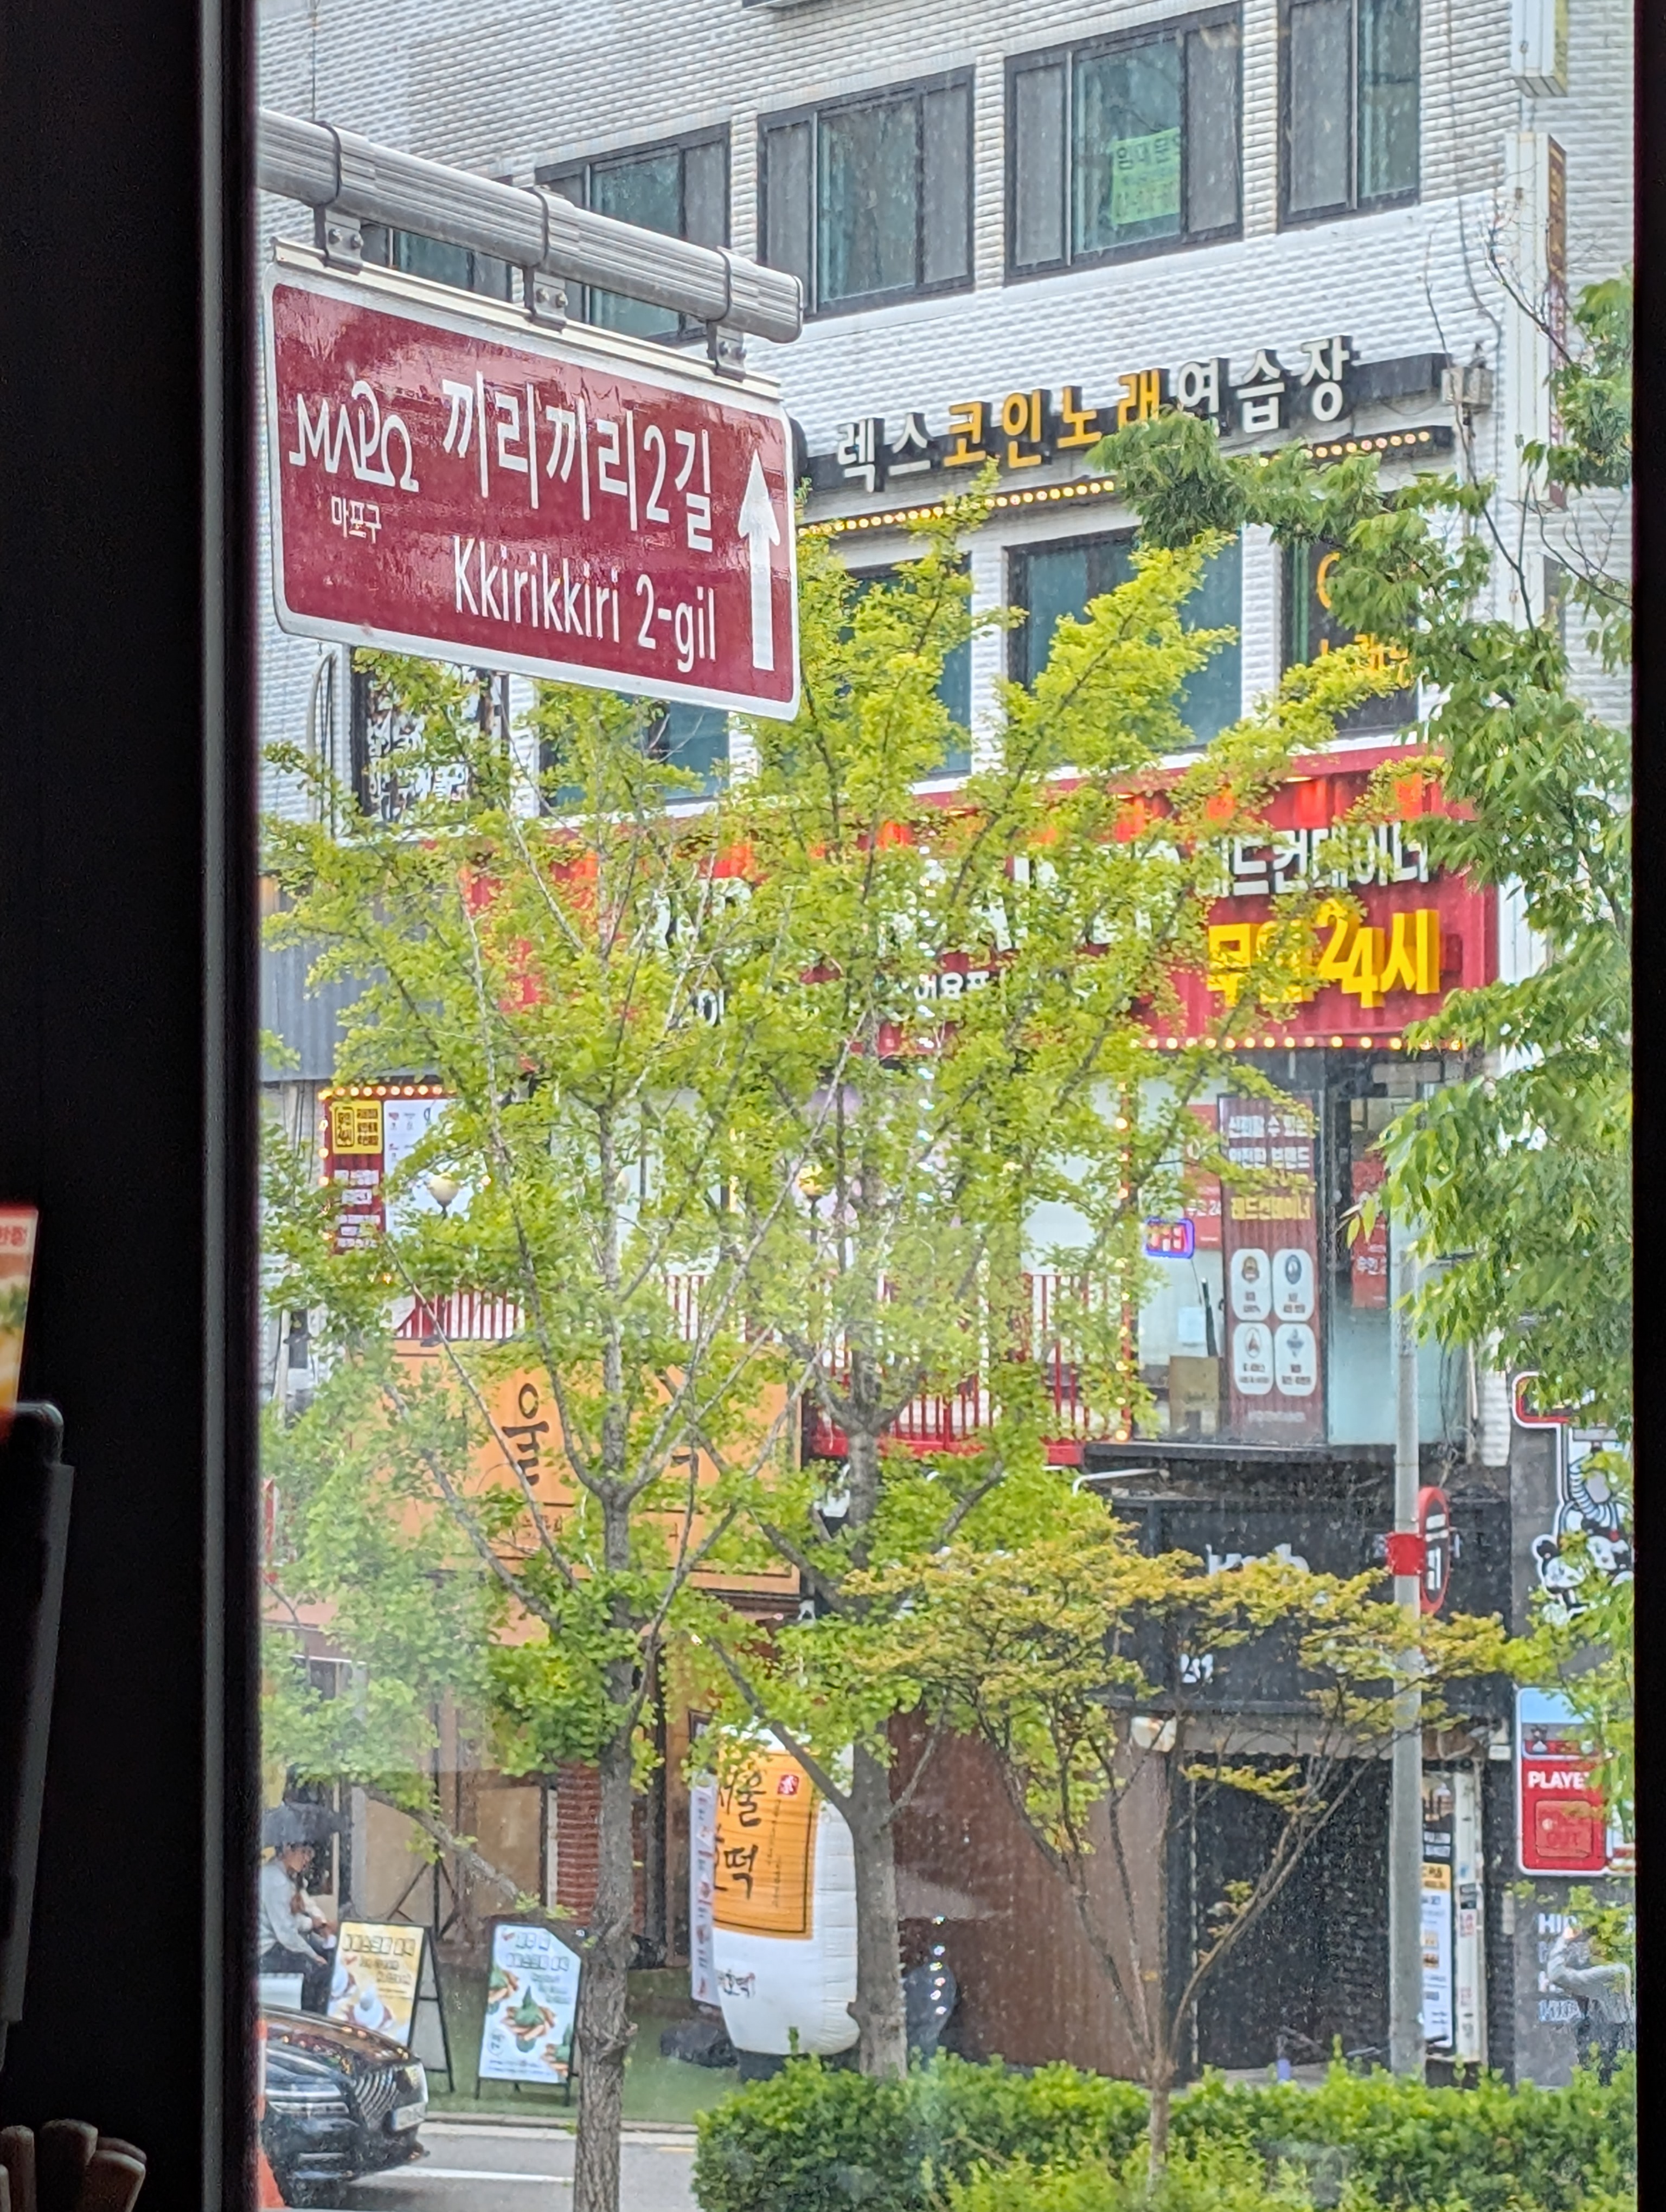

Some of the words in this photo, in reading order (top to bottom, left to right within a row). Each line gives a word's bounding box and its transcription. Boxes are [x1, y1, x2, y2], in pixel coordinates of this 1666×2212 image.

[441, 370, 713, 552] 끼리끼리2길
[331, 496, 382, 544] 마포구
[454, 536, 619, 644] Kkirikkiri
[636, 574, 716, 673] 2-gil
[1527, 1771, 1590, 1790] PLAYE
